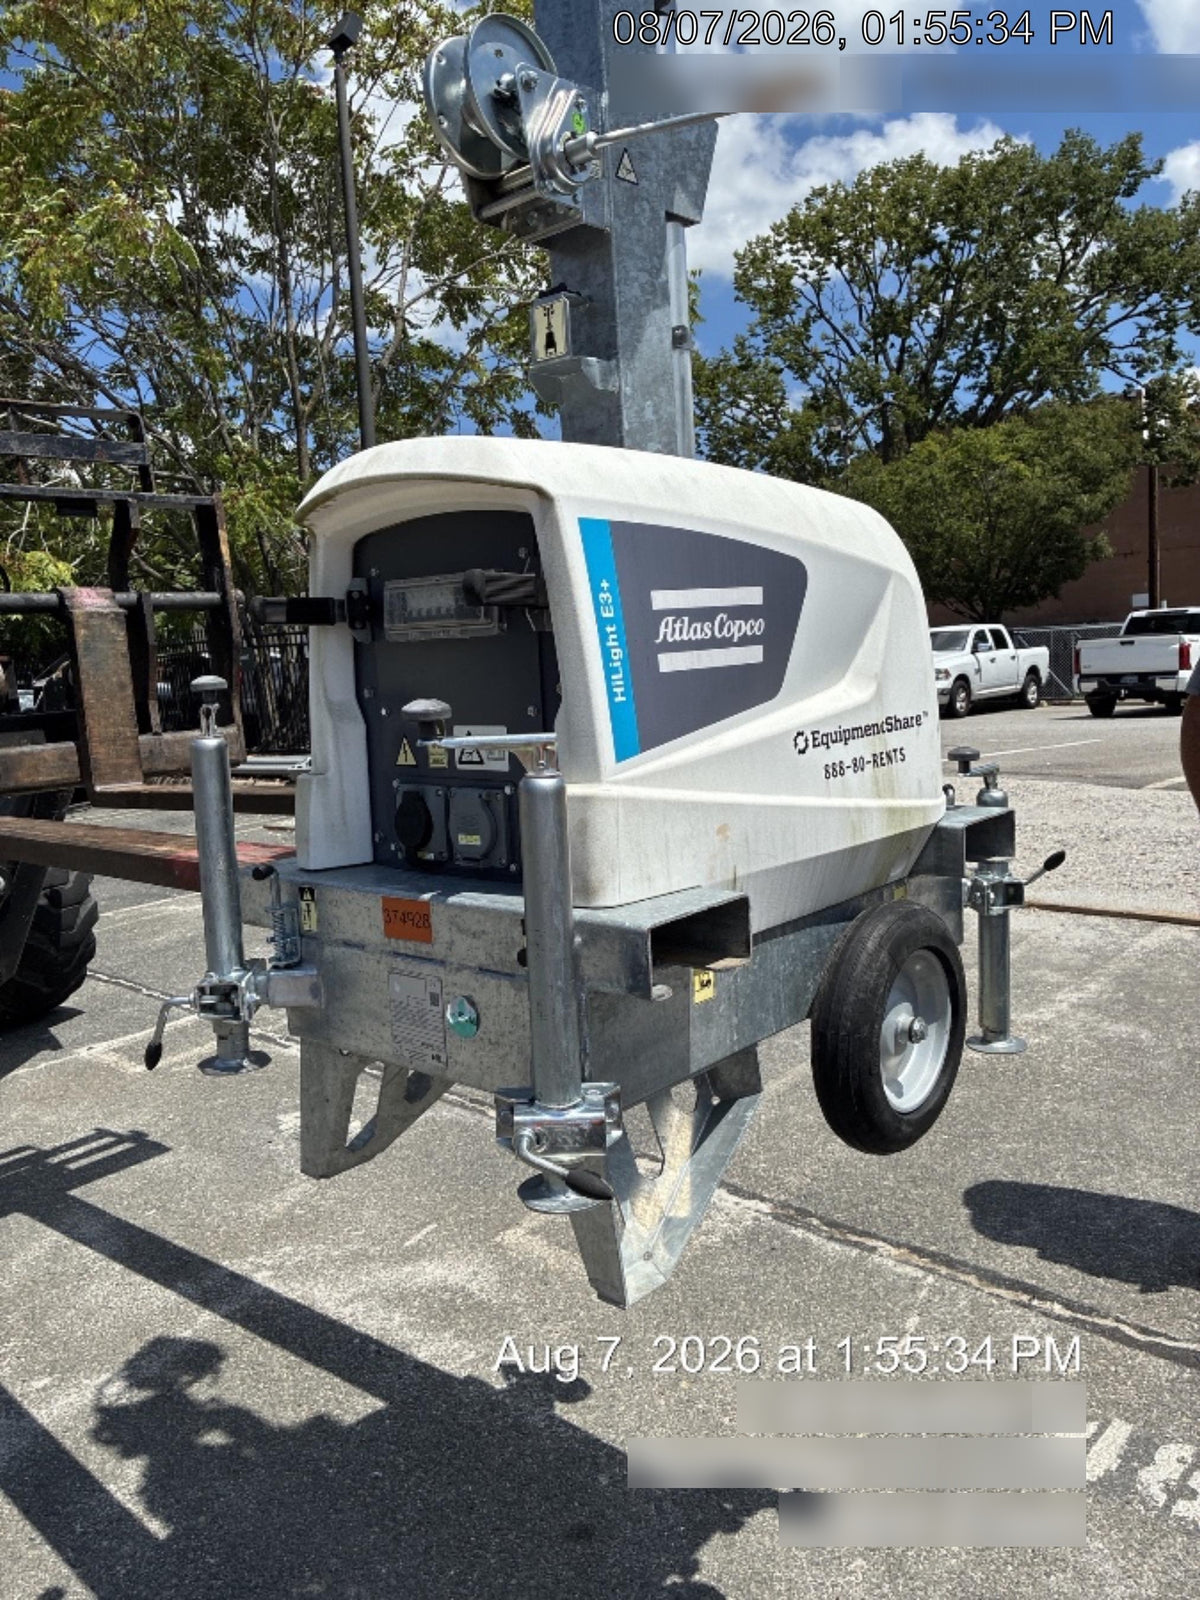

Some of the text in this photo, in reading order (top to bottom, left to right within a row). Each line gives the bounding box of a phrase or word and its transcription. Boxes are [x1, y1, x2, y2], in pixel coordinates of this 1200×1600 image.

[599, 579, 615, 618] E3+
[655, 612, 765, 643] Atlas Copco
[824, 747, 906, 780] 888-80-RENTS
